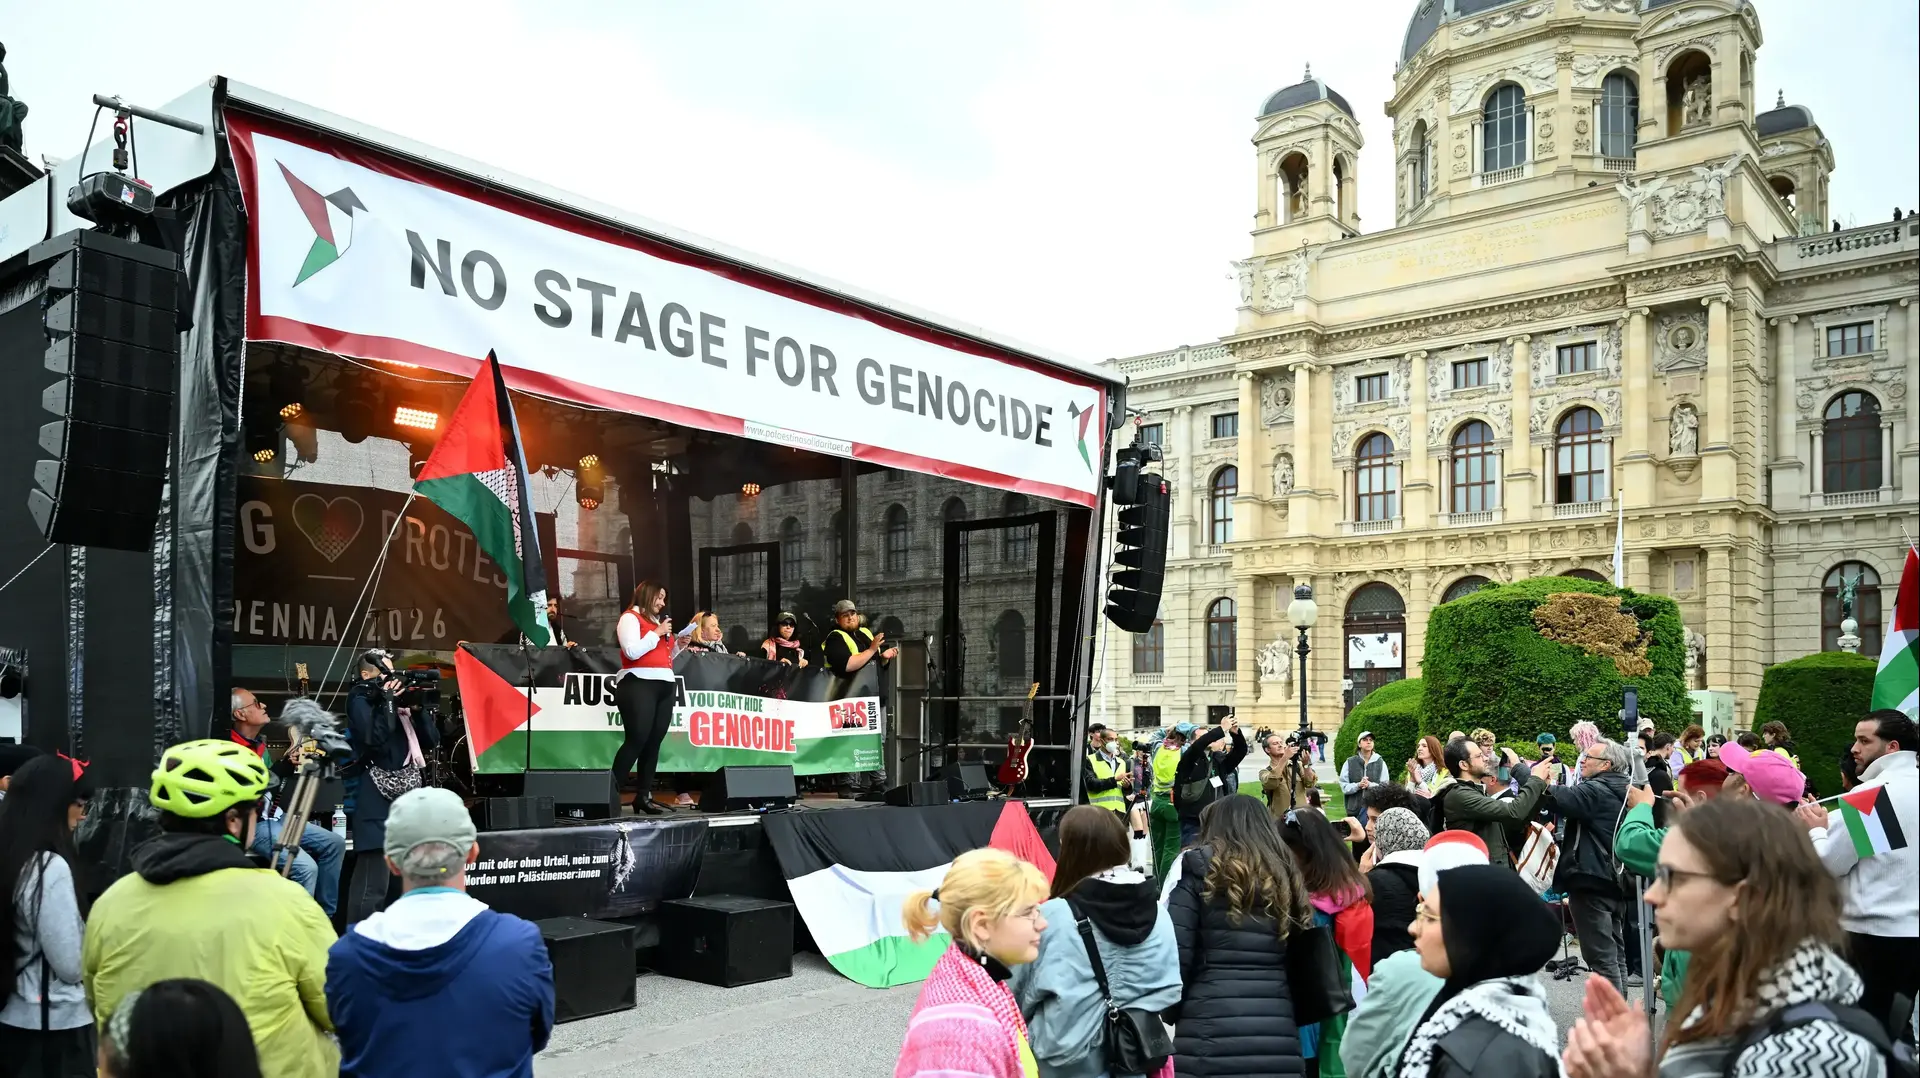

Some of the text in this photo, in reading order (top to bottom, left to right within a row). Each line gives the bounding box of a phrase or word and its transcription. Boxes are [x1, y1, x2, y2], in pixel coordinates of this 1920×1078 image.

[405, 228, 1053, 448] NO STAGE FOR GENOCIDE
[233, 599, 446, 641] IENNA 2026
[563, 674, 763, 713] AUSA YOU CAN'T HIDE
[606, 712, 624, 726] YO
[689, 711, 796, 752] GENOCIDE
[829, 701, 867, 729] BDS
[868, 701, 877, 731] AUSTRIA
[464, 868, 600, 886] Morden von Palästinenser:innen
[479, 859, 495, 870] mit
[497, 858, 518, 869] oder
[520, 857, 541, 868] ohne
[544, 855, 570, 867] Urteil,
[572, 854, 590, 865] nein
[592, 855, 609, 864] zum
